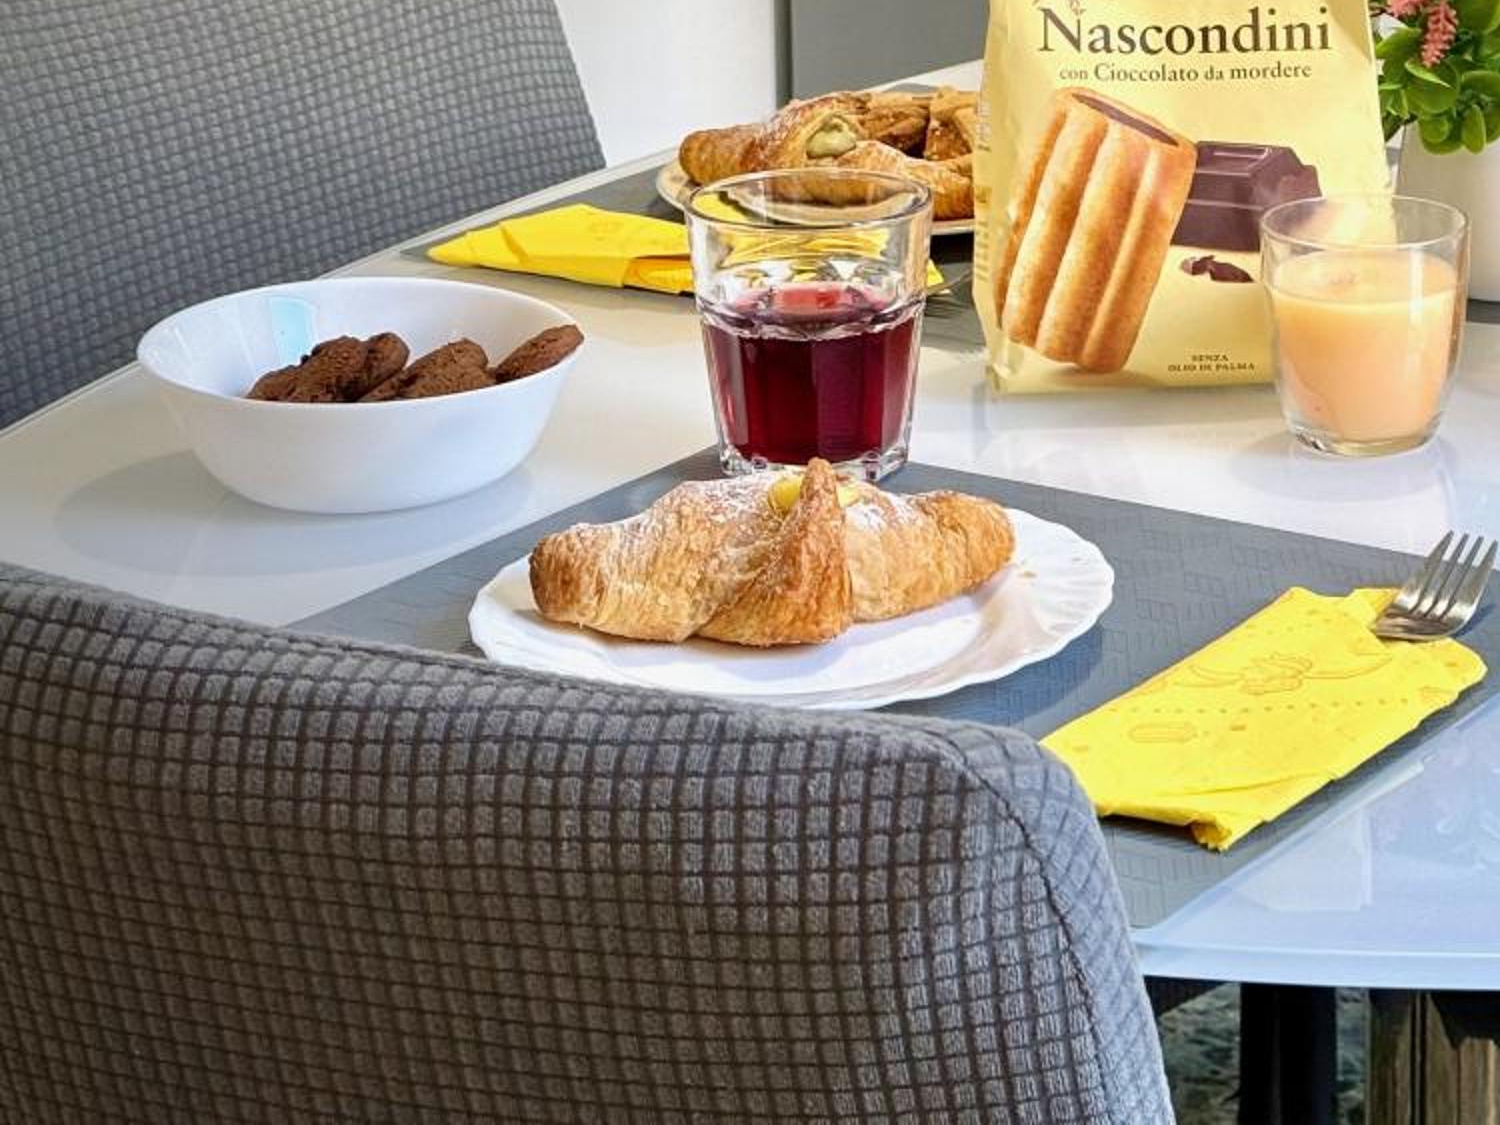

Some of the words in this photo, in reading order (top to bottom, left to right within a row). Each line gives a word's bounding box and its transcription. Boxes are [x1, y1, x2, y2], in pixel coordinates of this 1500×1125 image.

[1037, 5, 1333, 55] Nascondini
[1058, 66, 1089, 82] con
[1093, 62, 1200, 83] Cioccolato
[1203, 64, 1225, 82] da
[1229, 60, 1314, 81] mordere
[1191, 354, 1229, 362] SENZA
[1167, 364, 1197, 372] OLIO
[1215, 362, 1255, 372] PALMA
